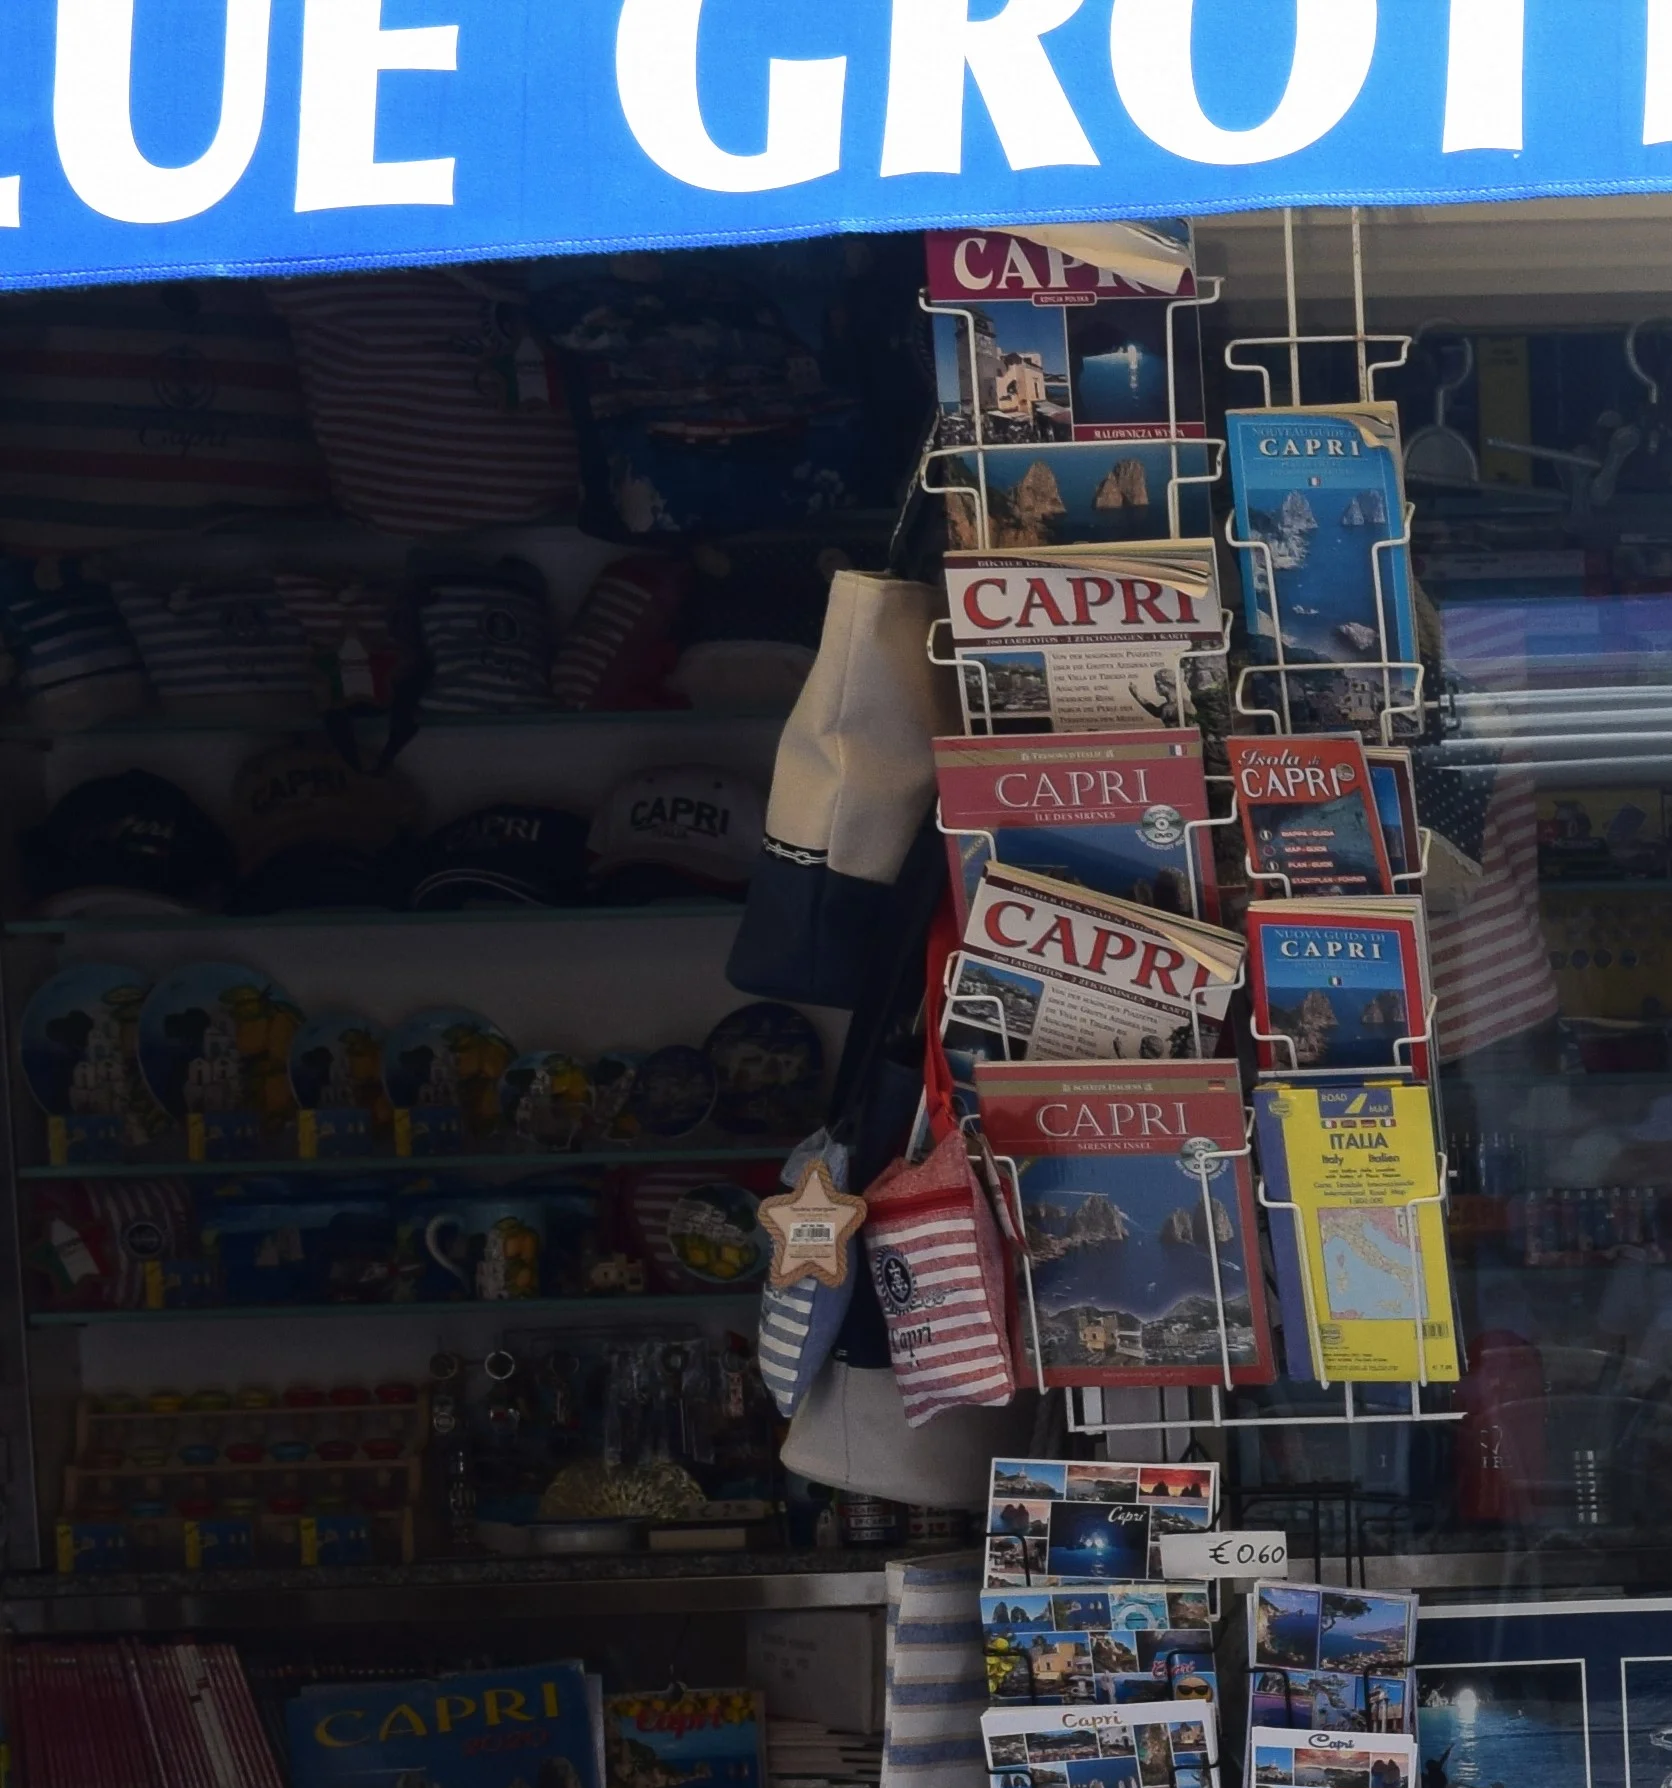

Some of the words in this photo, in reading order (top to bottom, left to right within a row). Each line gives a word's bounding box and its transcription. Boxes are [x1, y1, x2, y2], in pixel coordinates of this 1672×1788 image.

[0, 0, 458, 226] UE
[1259, 438, 1361, 457] CAPRI
[963, 575, 1201, 631] CAPRI
[1160, 632, 1191, 641] KARTE
[994, 767, 1153, 809] CAPRI
[1240, 765, 1343, 799] CAPRI
[629, 795, 731, 837] CAPRI
[1053, 811, 1073, 821] DES
[1274, 928, 1321, 940] NUOVA
[1324, 930, 1368, 942] GUIDA
[984, 899, 1208, 1007] CAPRI
[1280, 939, 1383, 960] CAPRI
[1321, 1093, 1349, 1103] ROAD
[1035, 1101, 1191, 1138] CAPRI
[1368, 1104, 1390, 1114] MAP
[1329, 1132, 1390, 1150] ITALIA
[1321, 1153, 1345, 1167] Italy
[1367, 1151, 1401, 1164] Italien
[1107, 1505, 1146, 1528] Capri
[313, 1680, 561, 1750] CAPRI
[635, 1703, 723, 1741] Capri
[1061, 1710, 1124, 1729] Capri
[1308, 1732, 1356, 1752] Capri
